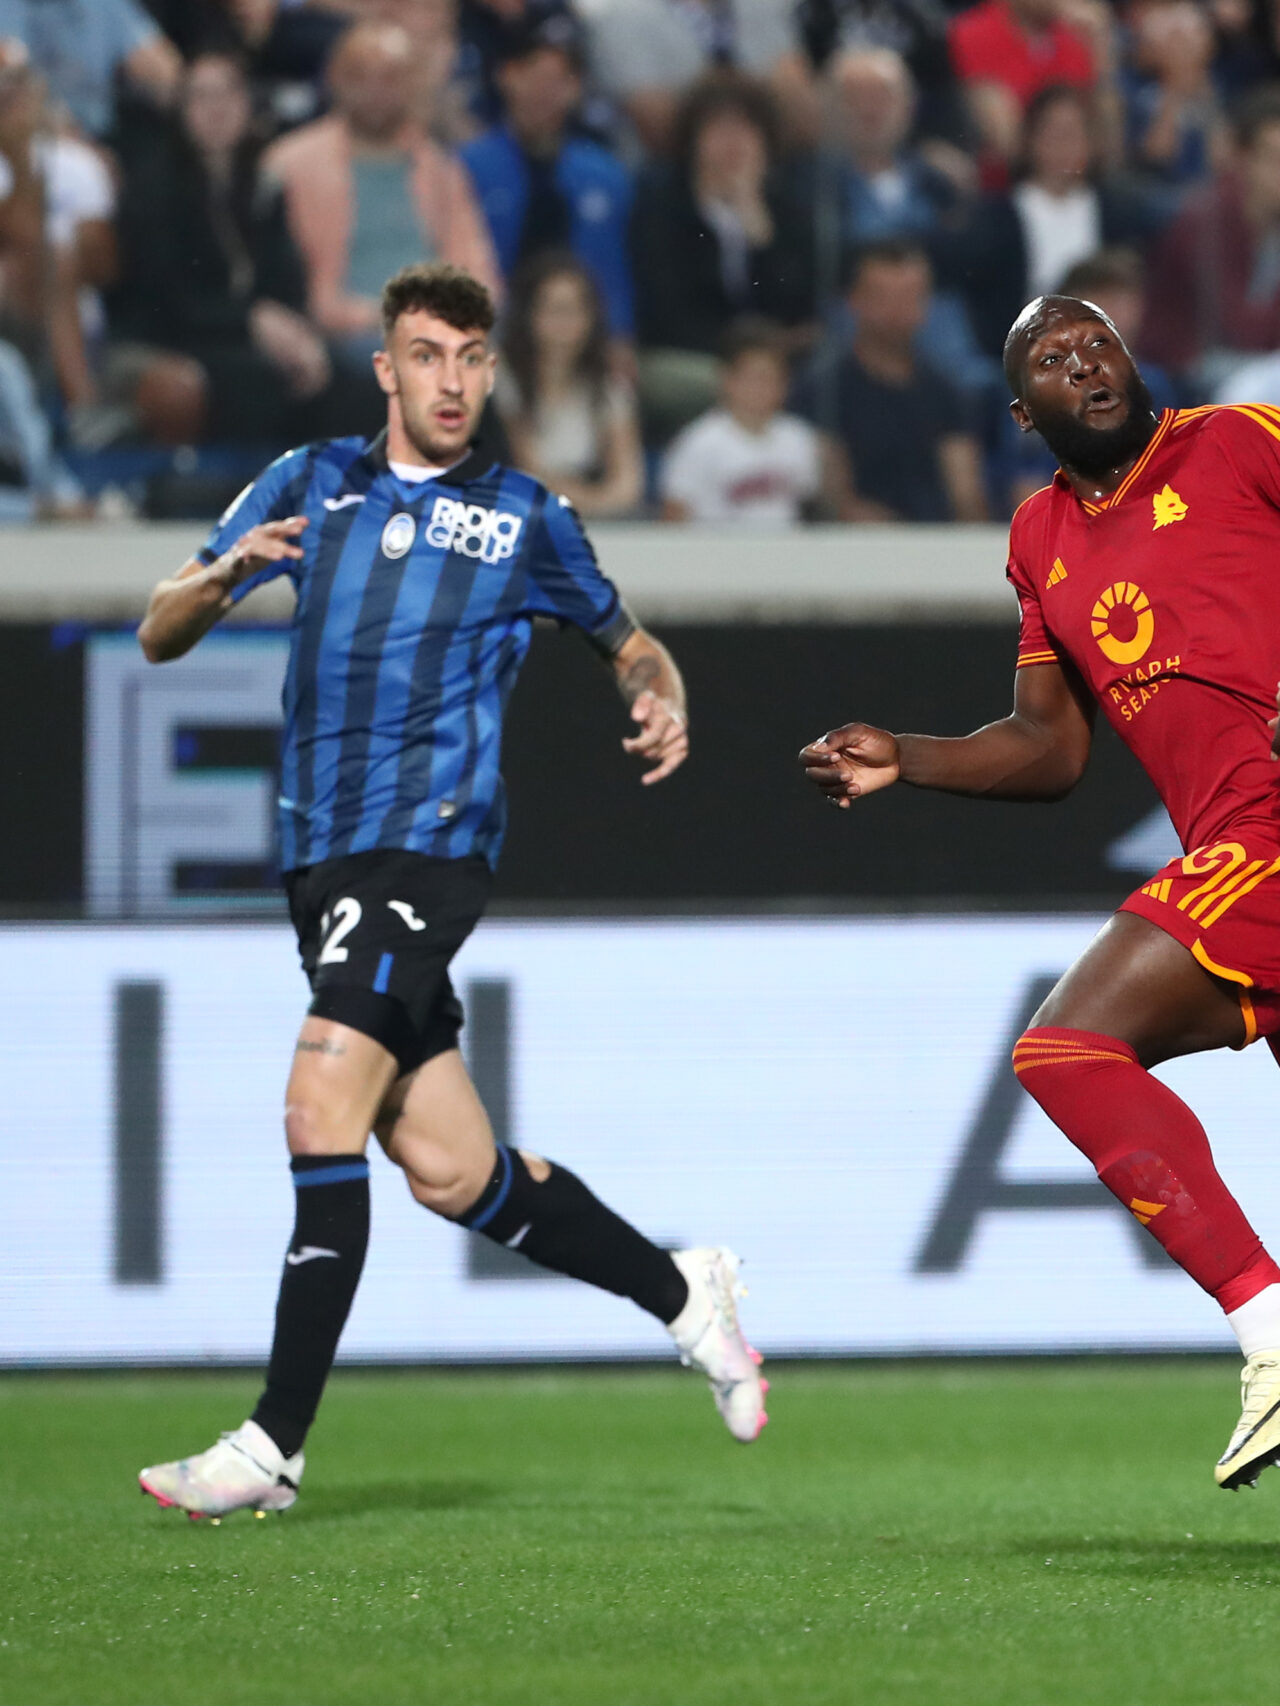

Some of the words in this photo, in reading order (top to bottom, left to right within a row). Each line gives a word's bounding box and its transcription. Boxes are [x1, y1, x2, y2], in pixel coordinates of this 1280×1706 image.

[425, 520, 514, 566] GROUP
[1109, 655, 1181, 704] RIYADH
[1120, 668, 1180, 722] SEAS
[319, 896, 363, 966] 2
